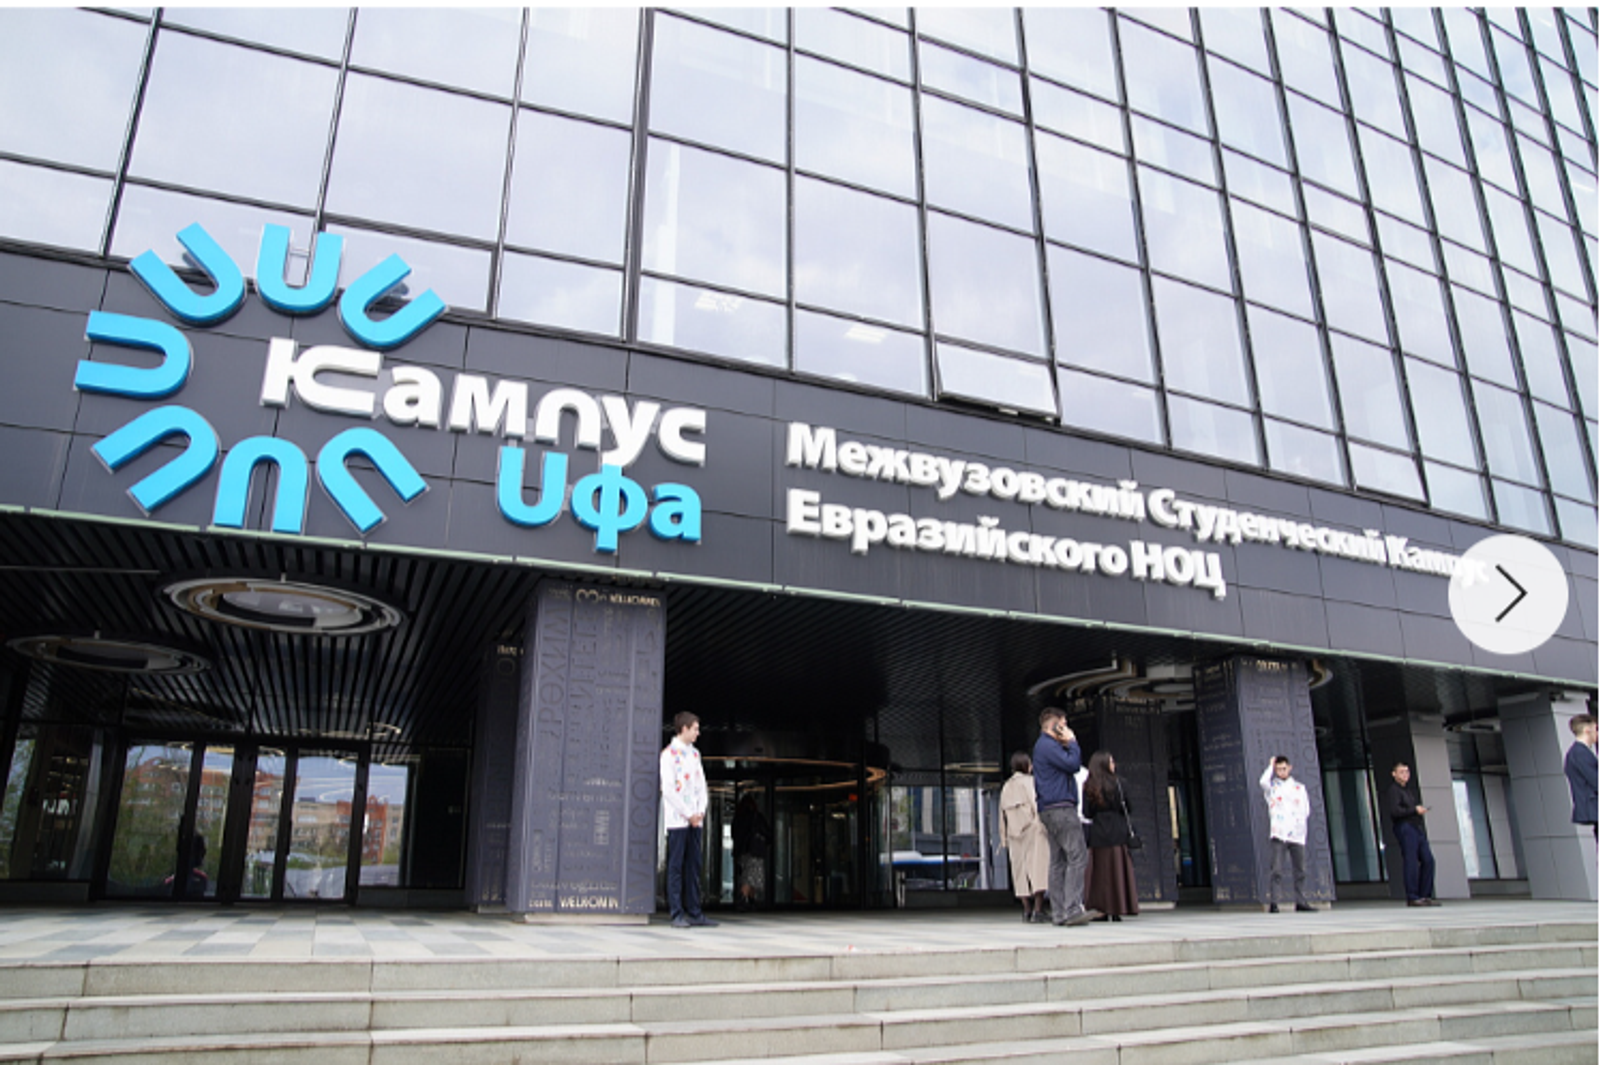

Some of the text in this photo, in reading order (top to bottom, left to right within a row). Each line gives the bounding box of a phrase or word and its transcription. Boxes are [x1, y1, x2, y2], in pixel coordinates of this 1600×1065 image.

[261, 336, 707, 467] Кампус
[786, 421, 1145, 522] Межвузовский
[1147, 488, 1386, 564] Студенческий
[786, 487, 1227, 600] Евразийского НОЦ
